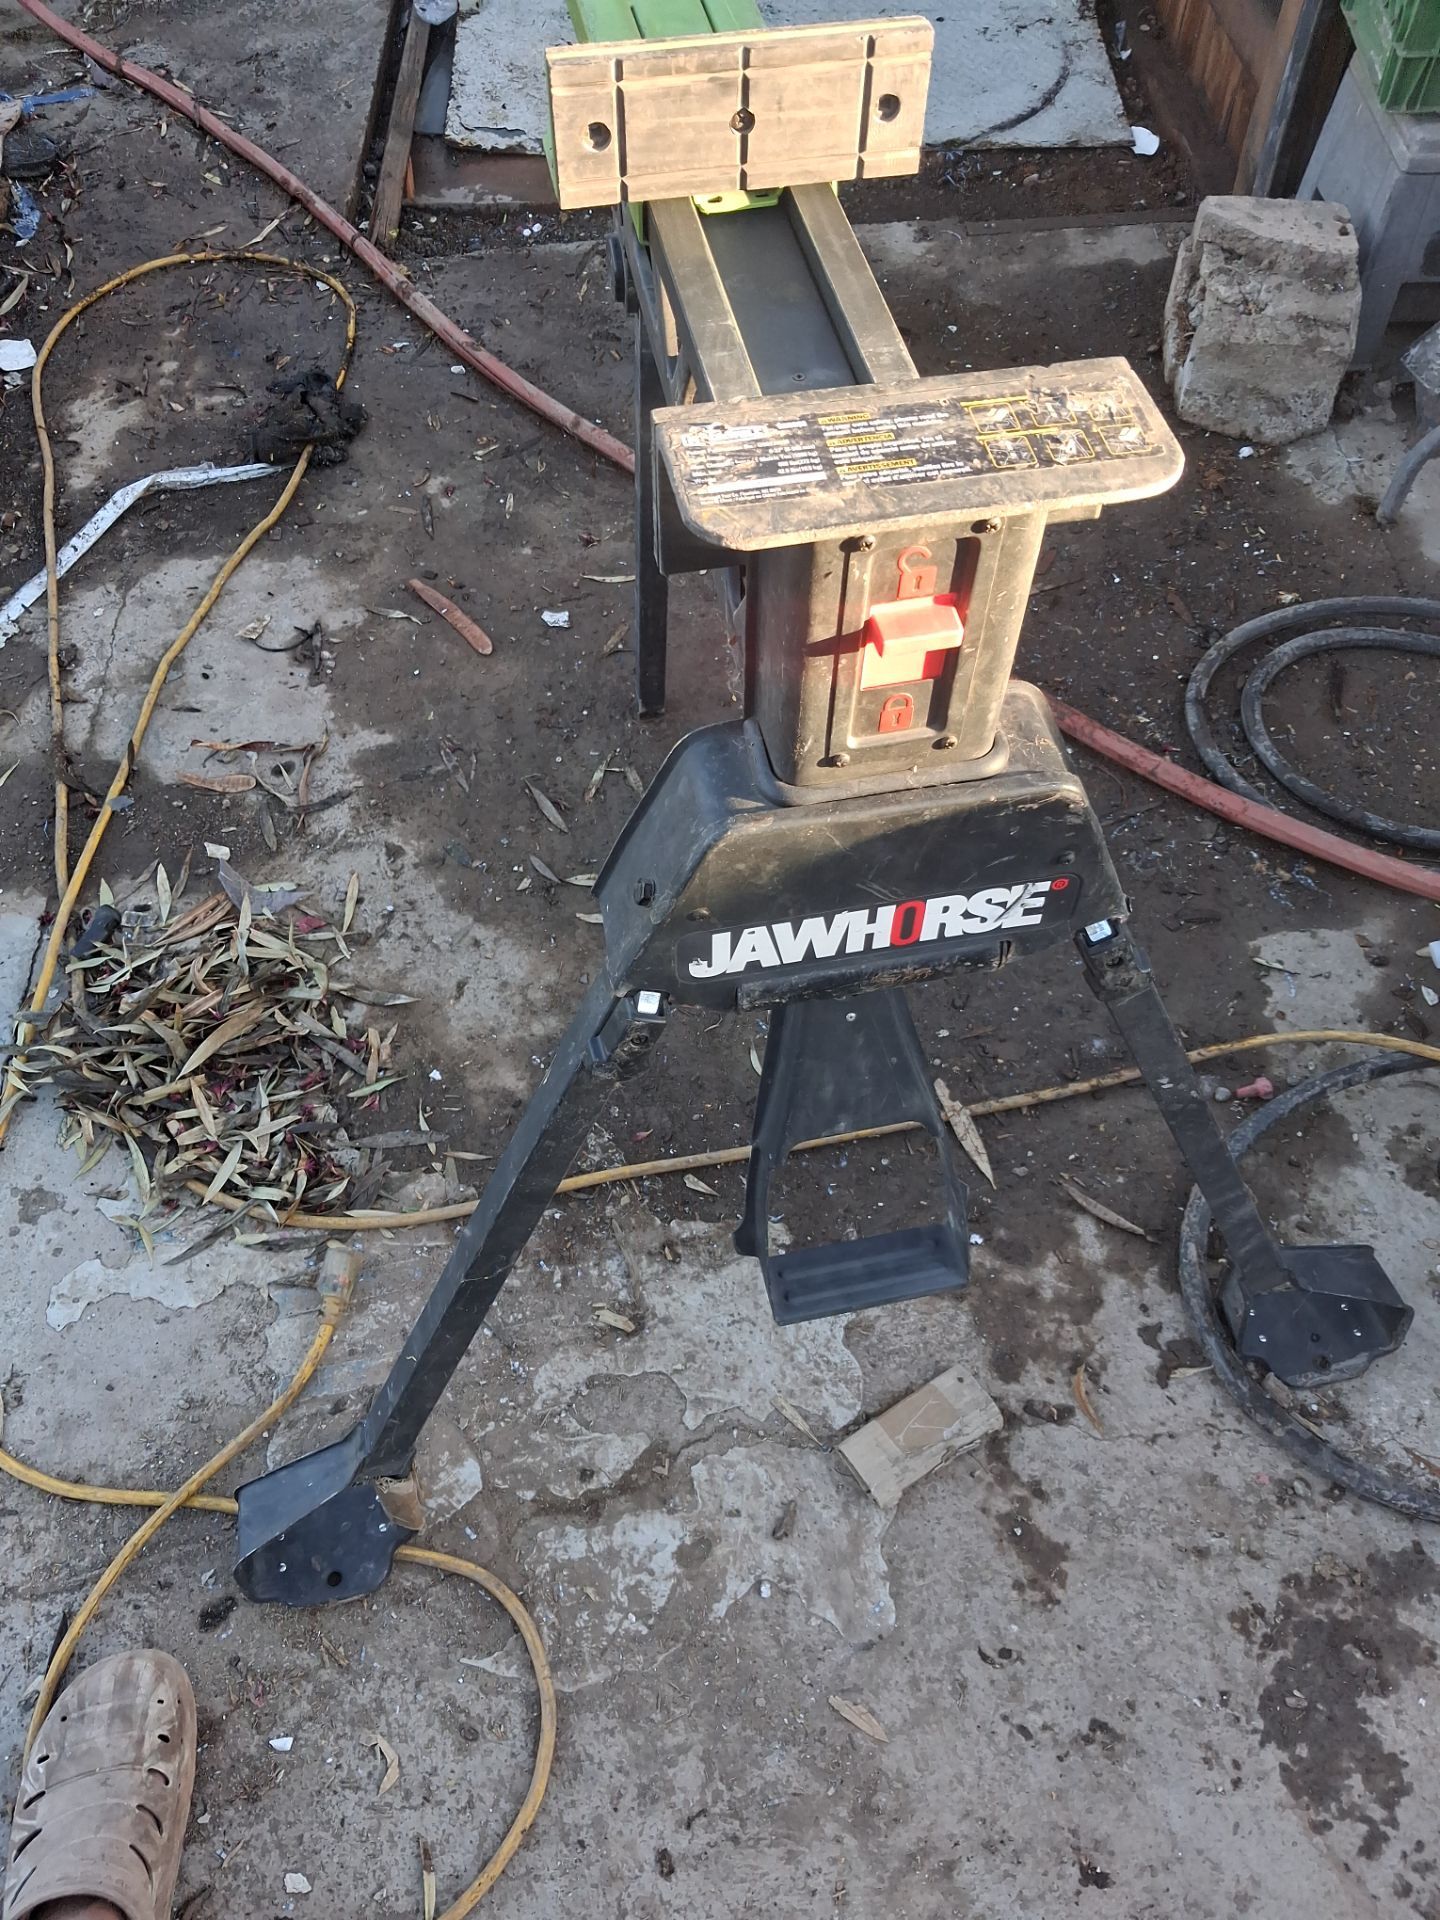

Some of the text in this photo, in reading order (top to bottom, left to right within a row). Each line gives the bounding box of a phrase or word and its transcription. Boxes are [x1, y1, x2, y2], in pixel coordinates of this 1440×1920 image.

[827, 413, 869, 423] WARNING
[847, 459, 914, 472] AVERTISSEMENT
[688, 880, 1051, 979] JAWHORSE
